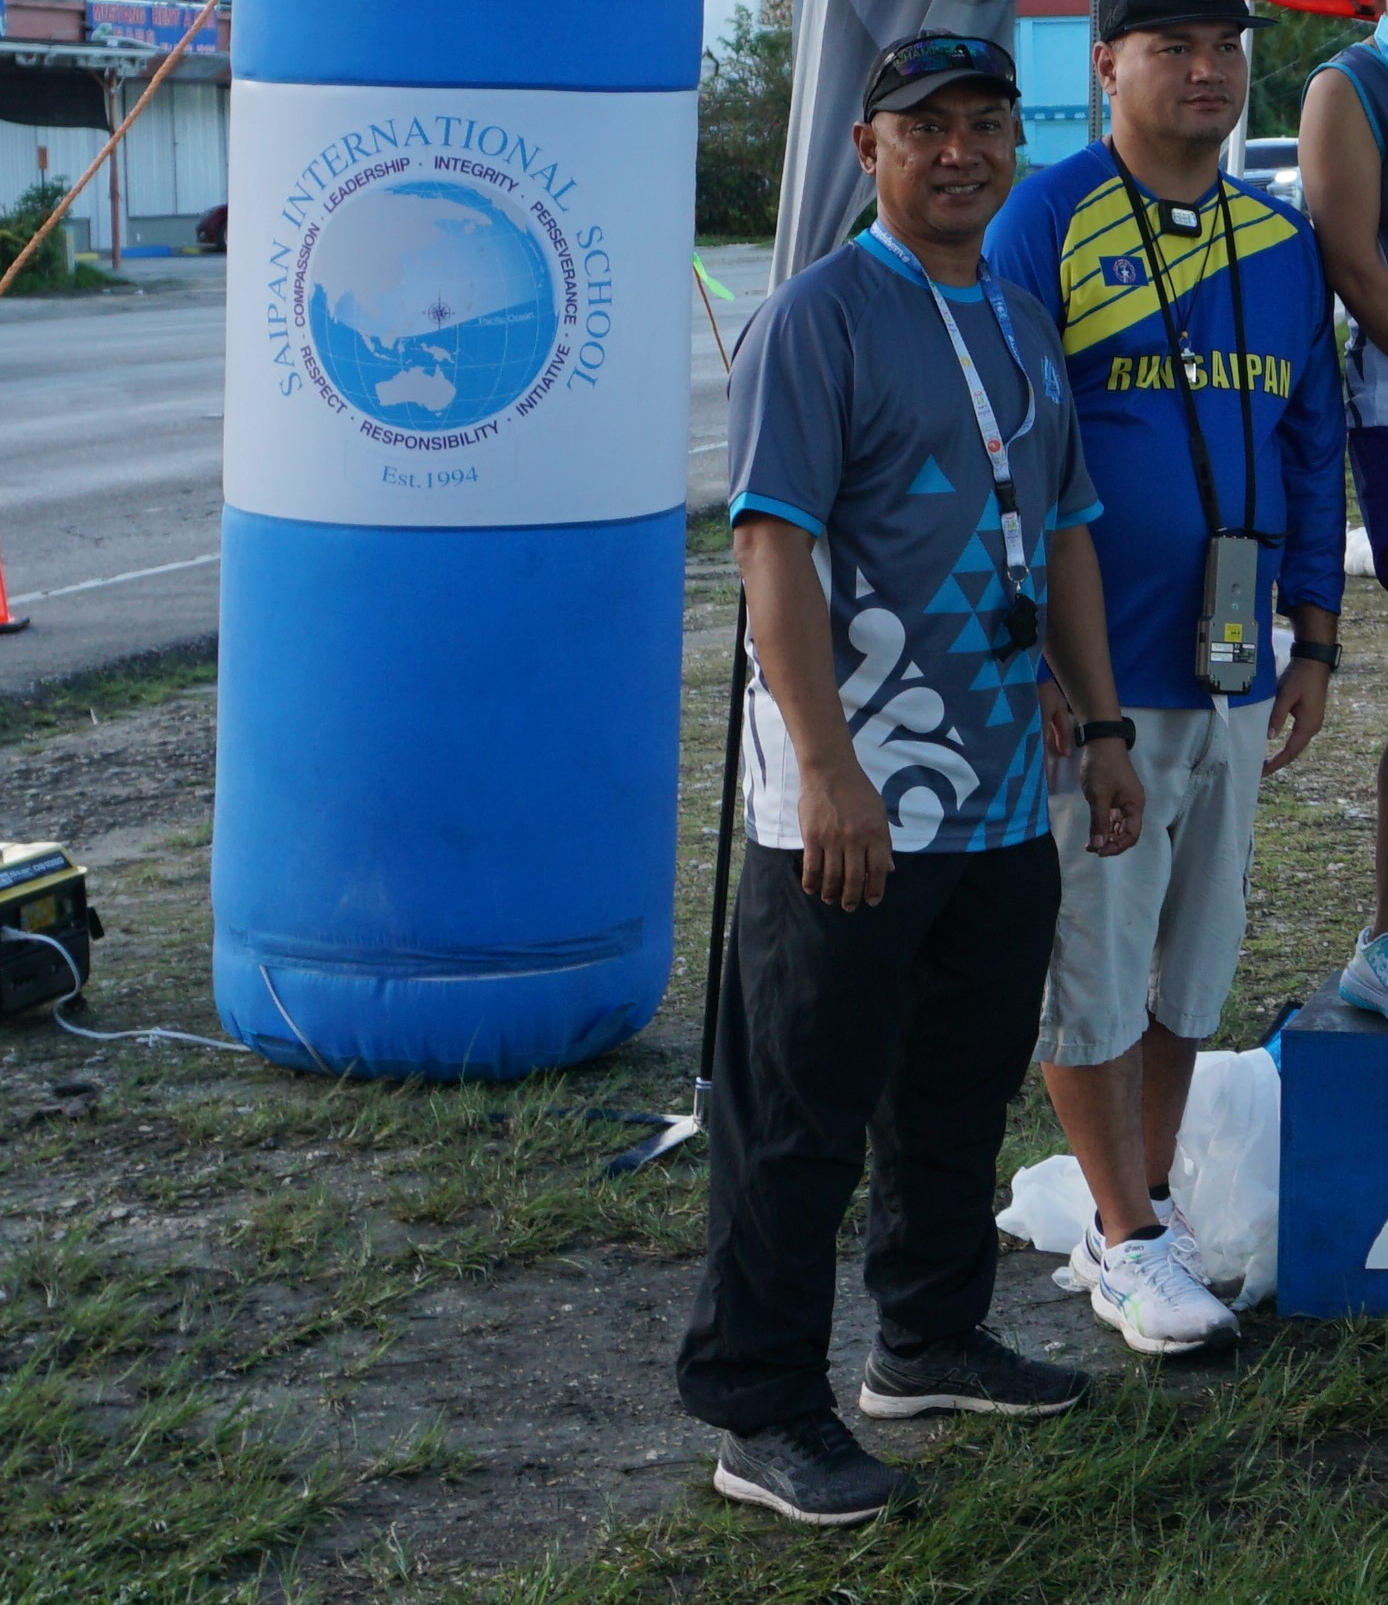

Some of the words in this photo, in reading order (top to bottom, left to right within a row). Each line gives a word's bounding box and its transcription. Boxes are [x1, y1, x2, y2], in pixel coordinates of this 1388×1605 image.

[282, 115, 580, 230] INTERNATIONAL
[293, 222, 321, 328] COMPASSION
[323, 157, 411, 213] LEADERSHIP
[434, 155, 519, 193] INTEGRITY
[530, 201, 577, 325] PERSEVERANCE
[568, 225, 612, 392] SCHOOL
[268, 238, 303, 397] SAIPAN
[1106, 355, 1176, 392] RUN
[1188, 350, 1292, 399] SAIPAN
[300, 345, 348, 415] RESPECT
[360, 419, 501, 451] RESPONSIBILITY
[516, 344, 571, 417] INITIATIVE
